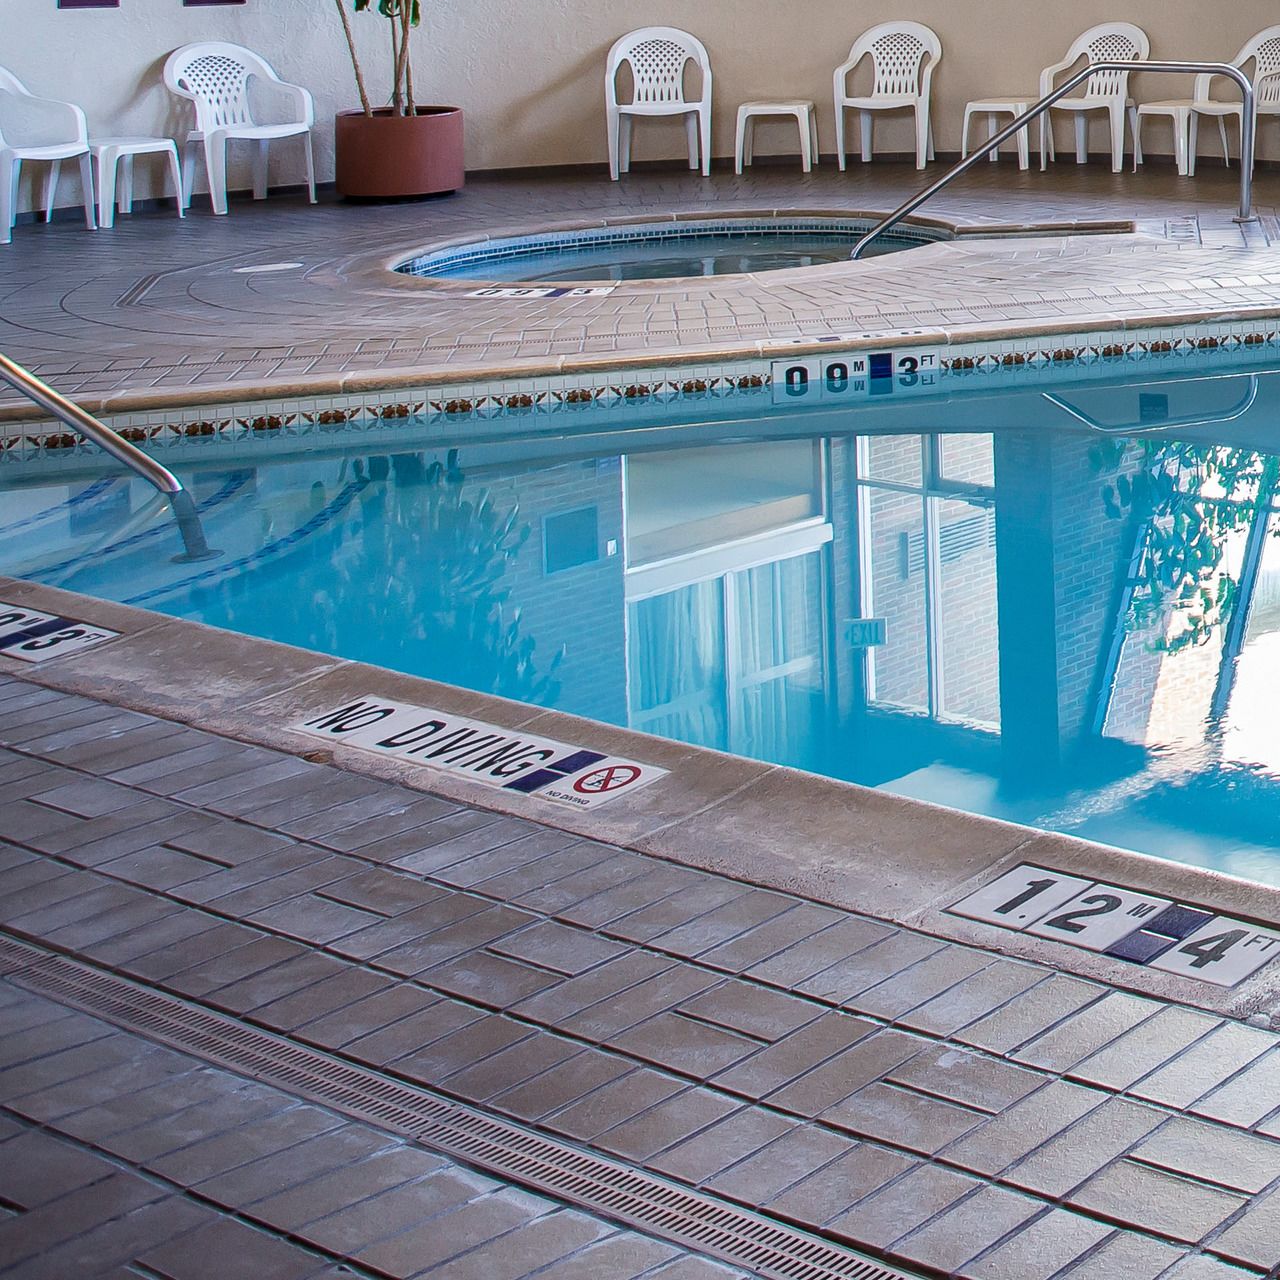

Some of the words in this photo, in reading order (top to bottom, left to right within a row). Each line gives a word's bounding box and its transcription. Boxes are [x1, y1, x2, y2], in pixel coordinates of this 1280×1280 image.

[854, 360, 864, 372] M
[898, 356, 918, 376] 3
[920, 354, 935, 366] FT
[21, 629, 86, 650] 3
[76, 632, 108, 642] FT
[304, 701, 396, 733] NO
[376, 720, 556, 779] DIVING
[560, 794, 590, 805] DIVING
[1126, 902, 1158, 919] M
[1178, 928, 1250, 968] 4
